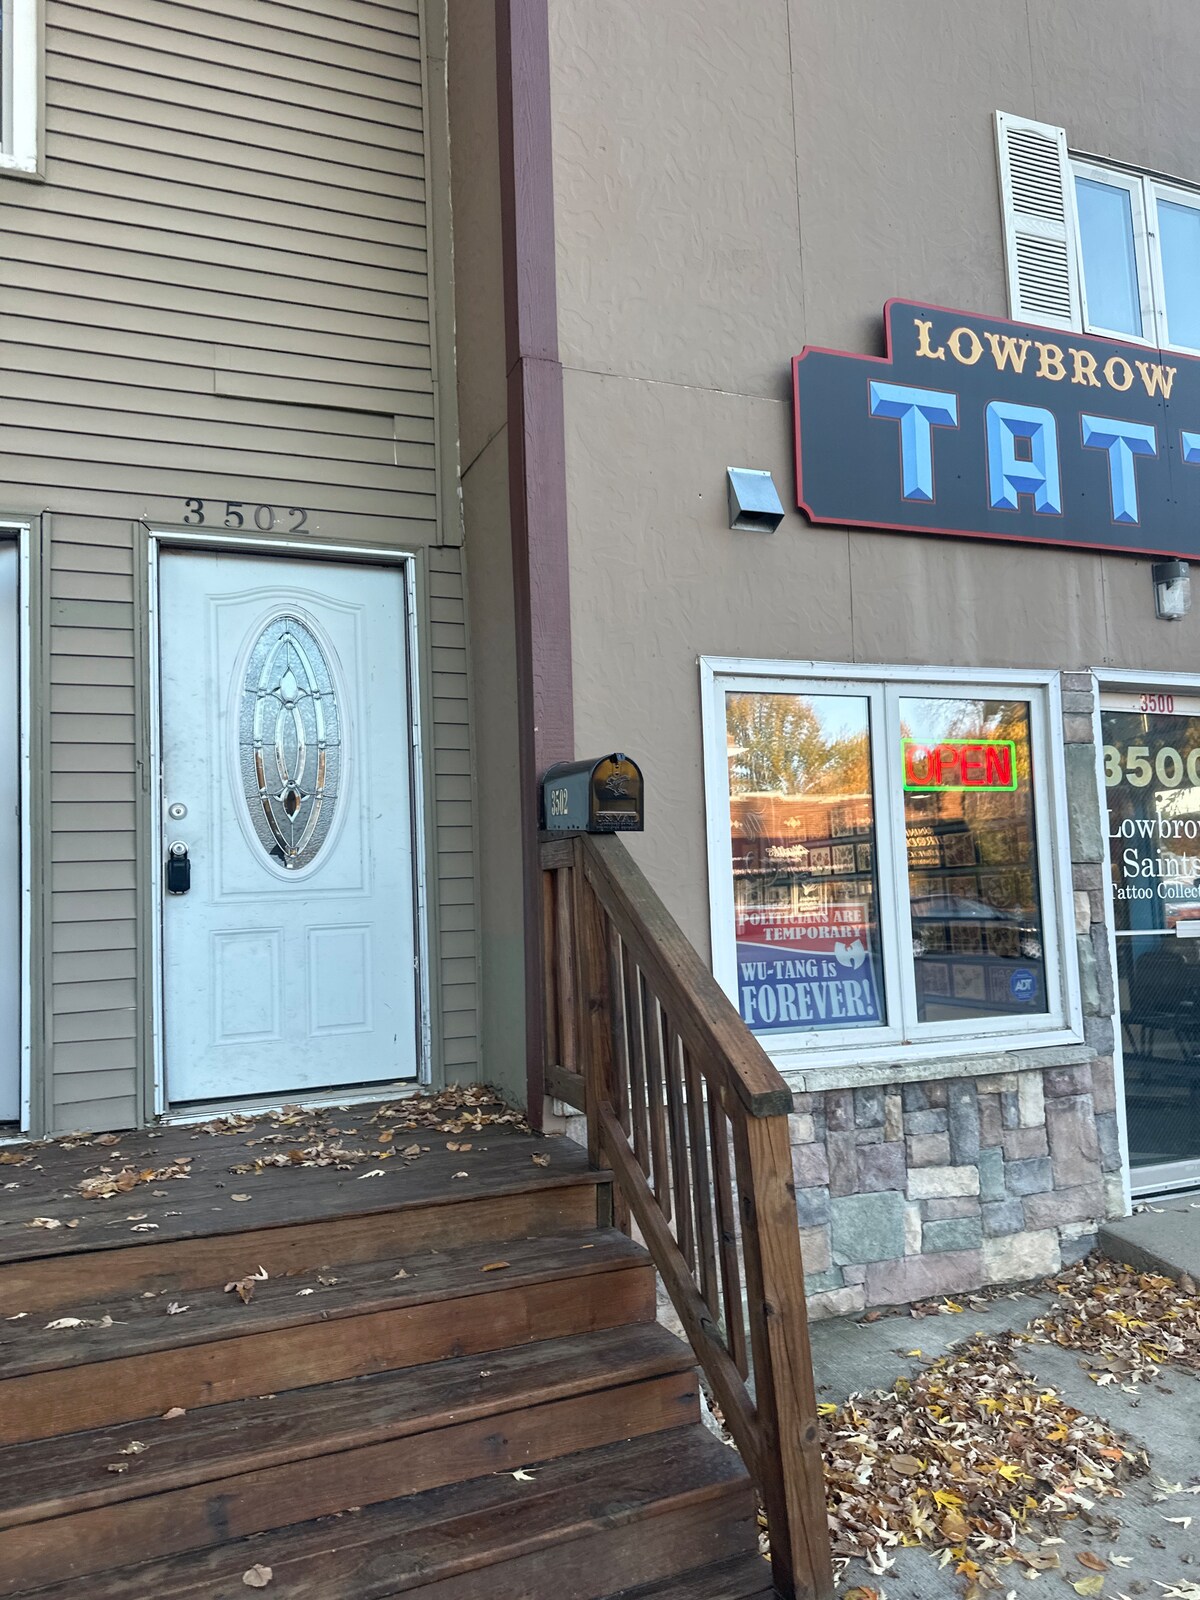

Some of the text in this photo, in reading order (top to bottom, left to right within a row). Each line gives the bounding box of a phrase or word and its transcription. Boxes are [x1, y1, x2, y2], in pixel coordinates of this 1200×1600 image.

[914, 319, 1177, 399] LOWBROW
[869, 381, 1200, 524] TAT
[184, 498, 310, 535] 3502
[1140, 693, 1174, 713] 3500
[906, 745, 1011, 785] OPEN
[551, 788, 569, 816] 3502
[738, 909, 862, 926] POLITICIANS ARE
[763, 925, 861, 941] TEMPORARY
[741, 959, 838, 981] WU-TANG is
[1014, 979, 1032, 991] ADT
[742, 979, 874, 1024] FOREVER!
